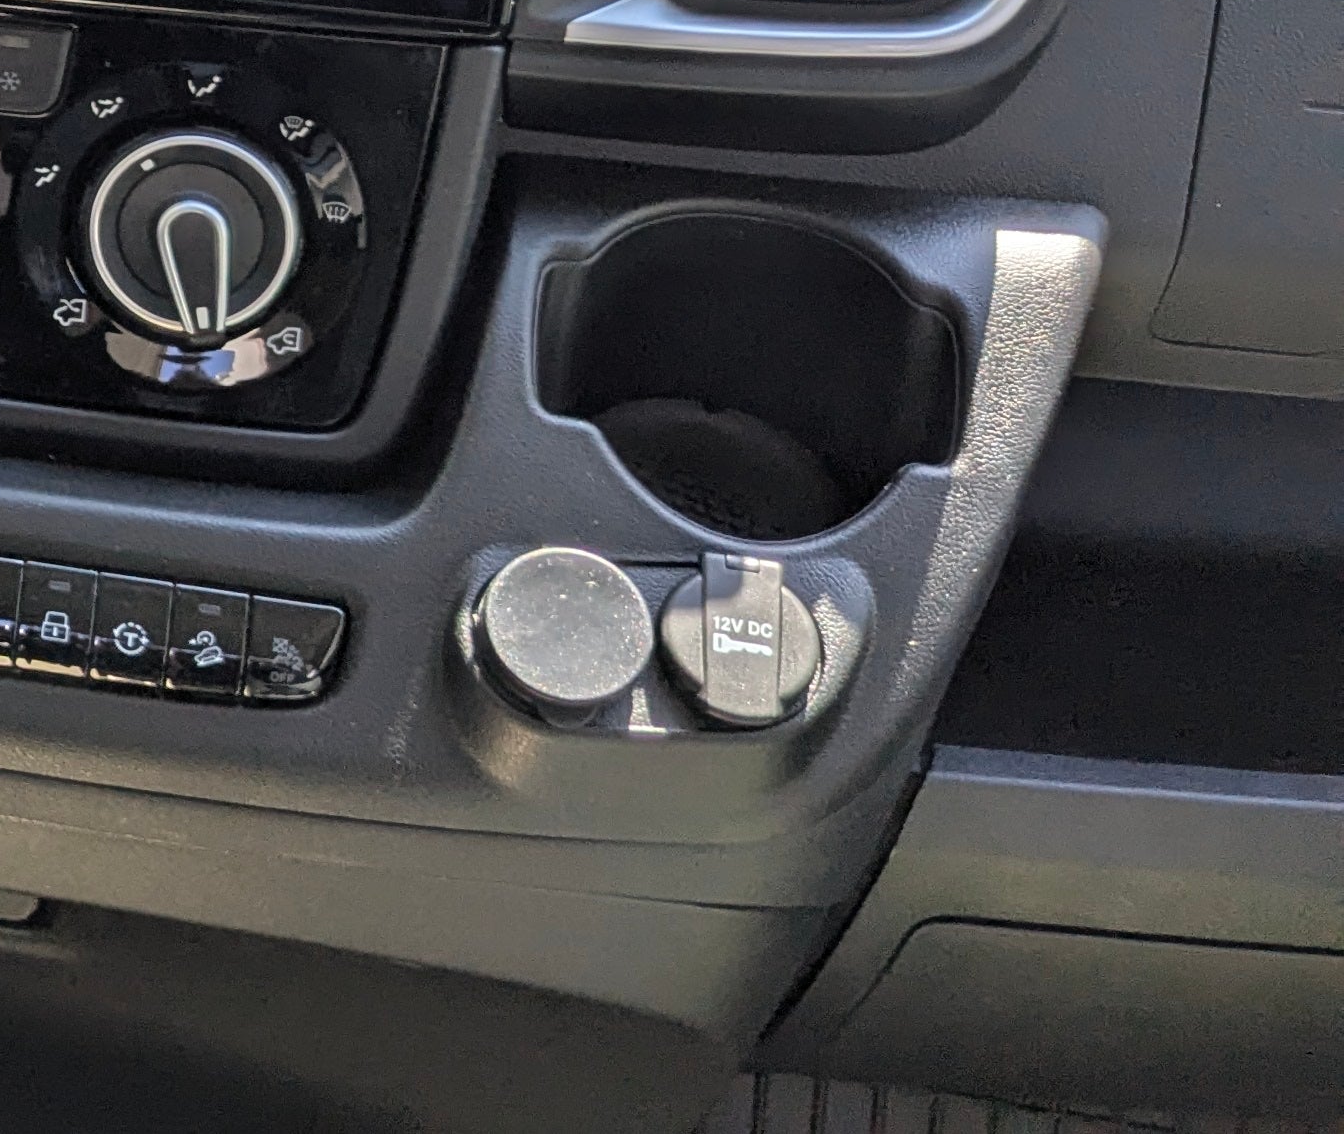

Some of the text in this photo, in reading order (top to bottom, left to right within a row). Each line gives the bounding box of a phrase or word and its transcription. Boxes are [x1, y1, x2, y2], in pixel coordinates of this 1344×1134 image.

[712, 615, 773, 639] 12V DC
[269, 670, 296, 683] OFF
